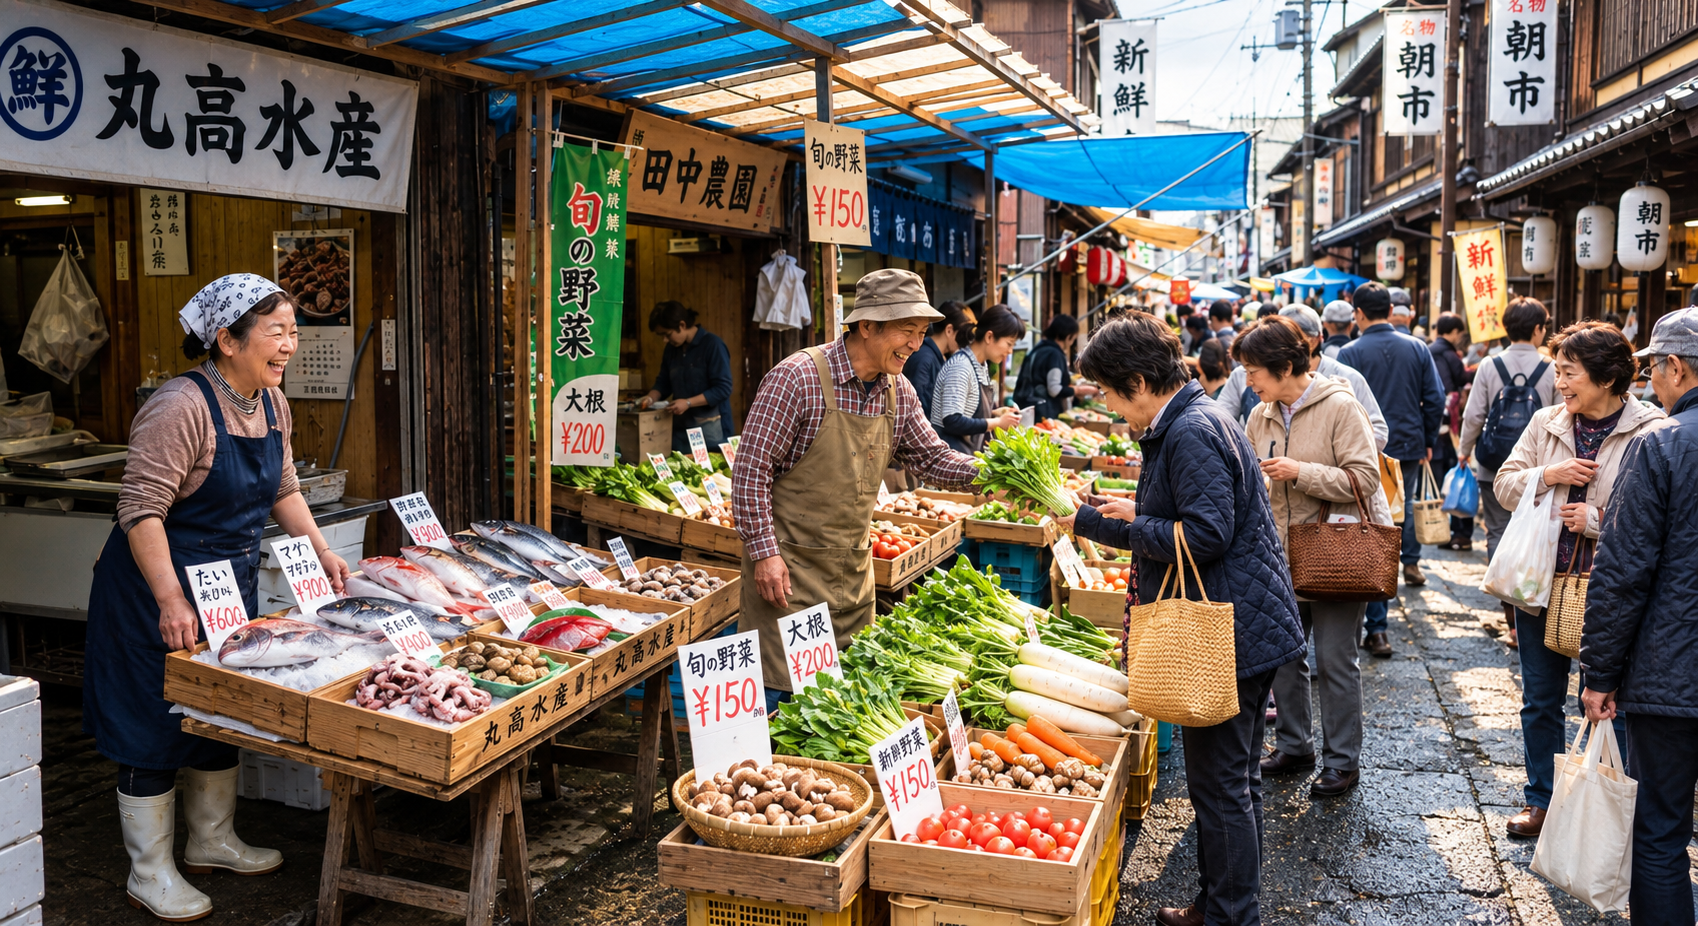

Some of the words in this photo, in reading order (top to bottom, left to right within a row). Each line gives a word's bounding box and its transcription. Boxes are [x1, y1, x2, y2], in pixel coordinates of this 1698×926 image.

[1400, 19, 1436, 36] 名物
[1507, 0, 1545, 13] 名物
[8, 45, 70, 126] 鮮
[1113, 38, 1149, 135] 新鮮
[1396, 41, 1436, 126] 朝市
[1503, 20, 1547, 115] 朝市
[96, 47, 382, 181] 丸高水産
[642, 148, 757, 214] 田中農園
[810, 137, 863, 175] 旬の野菜
[813, 185, 864, 228] ¥150
[1635, 201, 1663, 255] 朝市
[556, 182, 603, 361] 旬の野菜
[564, 387, 607, 414] 大根
[561, 422, 605, 454] ¥200
[195, 569, 227, 587] たい
[292, 576, 328, 603] ¥900
[613, 623, 675, 677] 丸高水産
[788, 612, 829, 647] 大根
[686, 638, 756, 678] 旬の野菜
[790, 642, 834, 682] ¥200
[482, 683, 569, 752] 丸高水産
[692, 677, 757, 727] ¥150
[885, 758, 930, 812] ¥150
